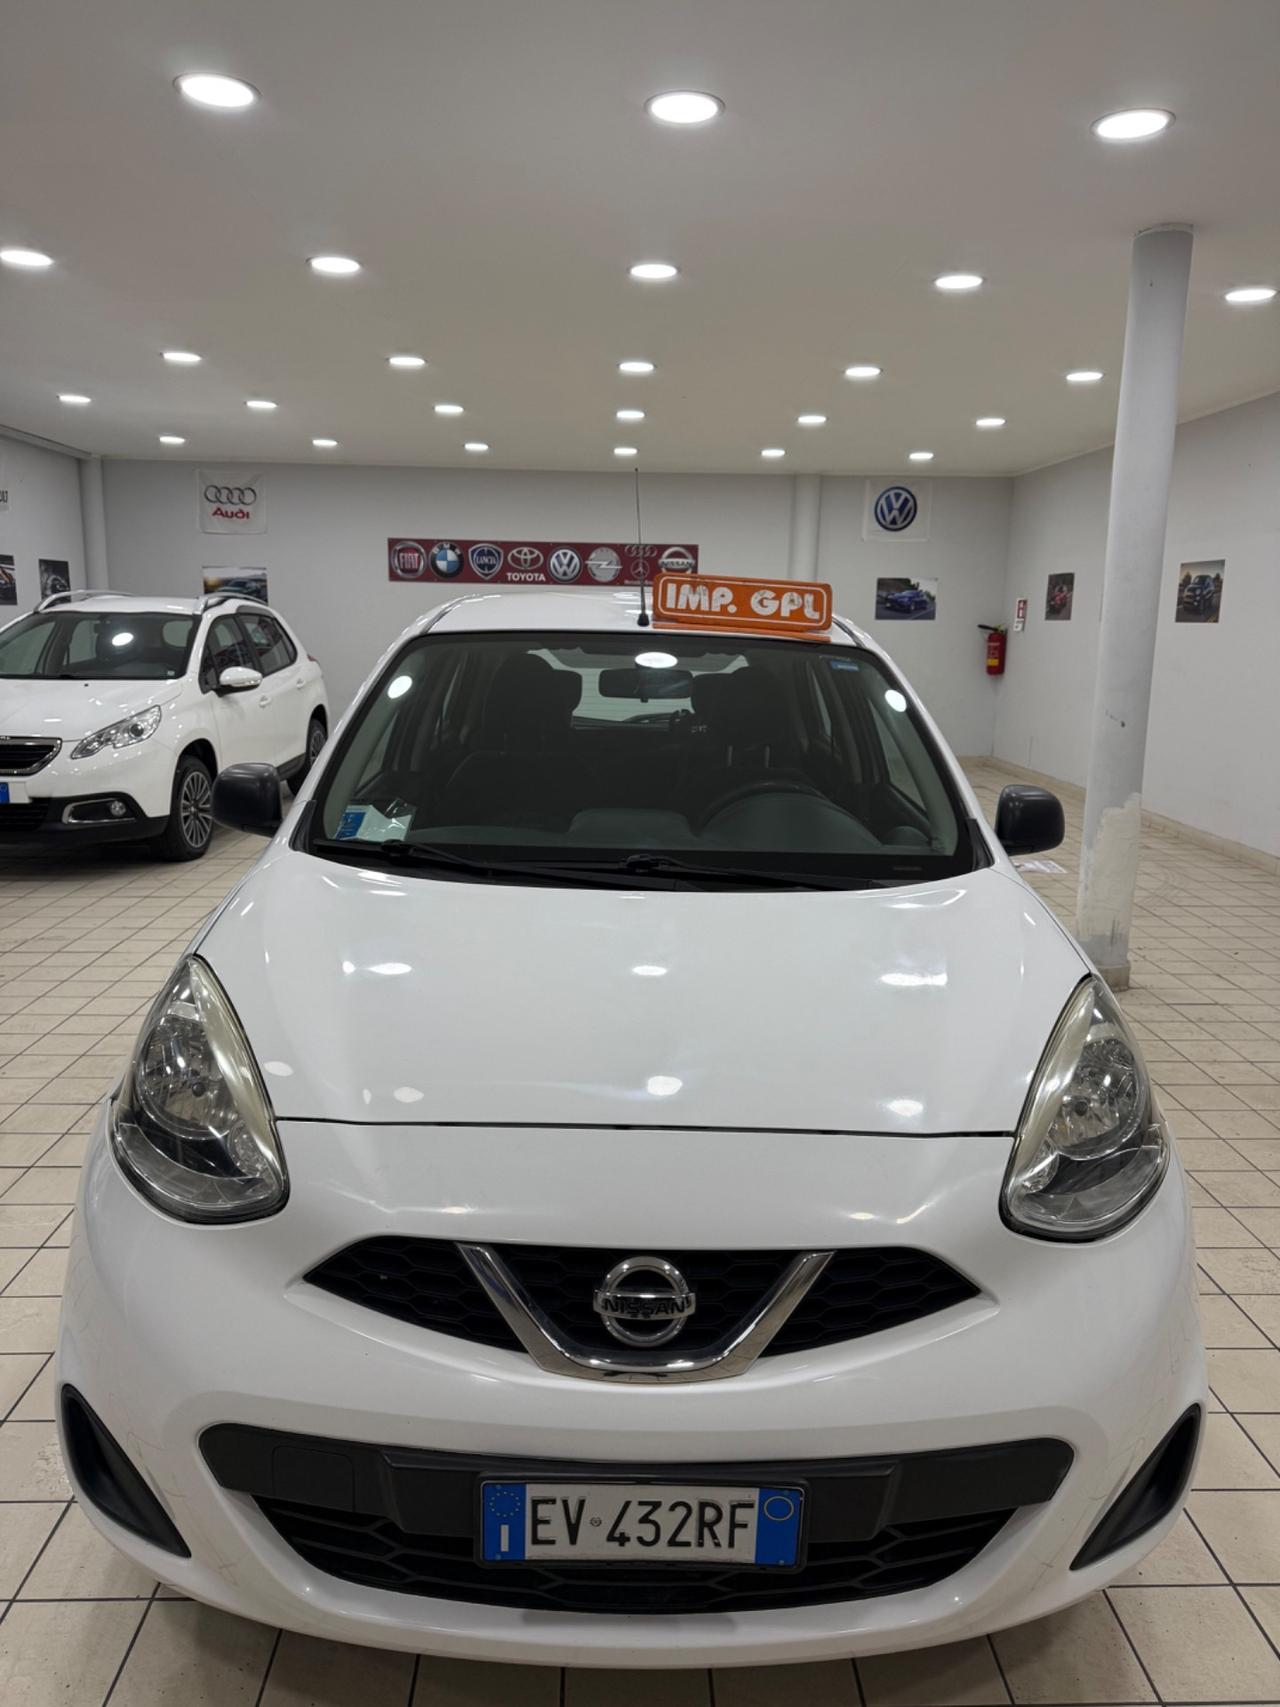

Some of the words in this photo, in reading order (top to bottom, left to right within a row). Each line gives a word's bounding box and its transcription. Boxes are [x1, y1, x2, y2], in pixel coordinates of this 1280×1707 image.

[211, 507, 250, 520] Audi
[399, 553, 418, 568] FIAT
[506, 572, 546, 582] TOYOTA
[666, 583, 737, 613] IMP.
[750, 590, 820, 619] GPL
[603, 1298, 686, 1315] NISSAN
[530, 1496, 586, 1545] EV
[606, 1500, 755, 1548] 432RF
[499, 1524, 509, 1552] I
